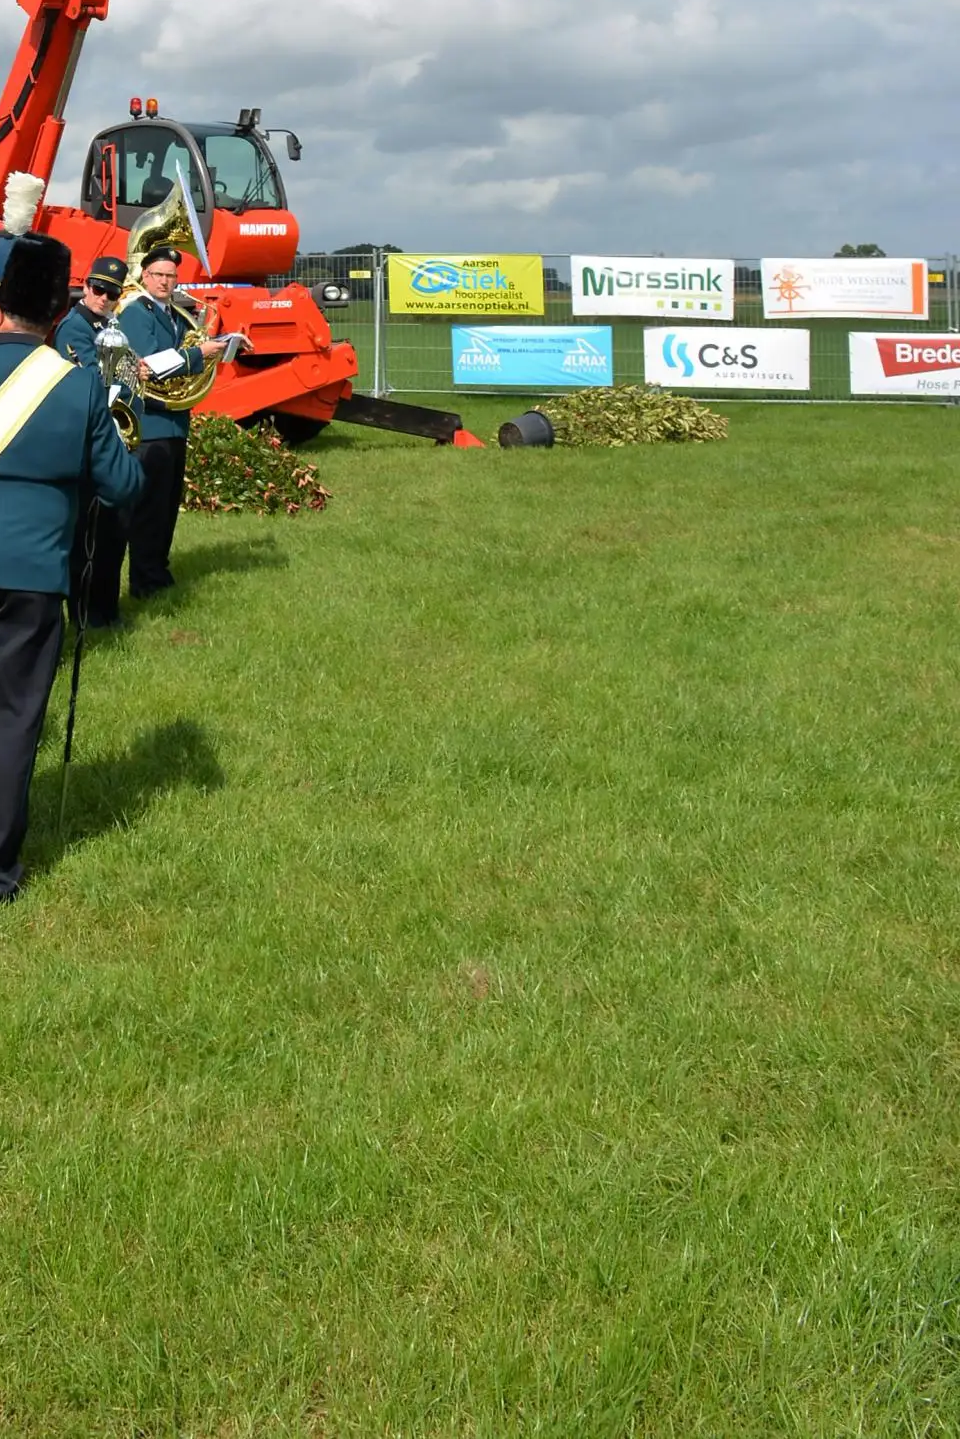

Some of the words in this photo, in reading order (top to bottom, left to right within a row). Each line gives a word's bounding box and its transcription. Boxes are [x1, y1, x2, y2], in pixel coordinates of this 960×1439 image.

[240, 223, 287, 236] MANITOU
[462, 259, 499, 268] Aarsen
[581, 266, 723, 297] Morssink
[847, 275, 907, 286] WESSELINK
[455, 290, 523, 300] hoorspecialist
[406, 300, 529, 312] www.aarsenoptiek.nl
[458, 353, 501, 366] ALMAX
[562, 354, 607, 367] ALMAX
[698, 343, 758, 369] C&S
[916, 379, 950, 390] Hose
